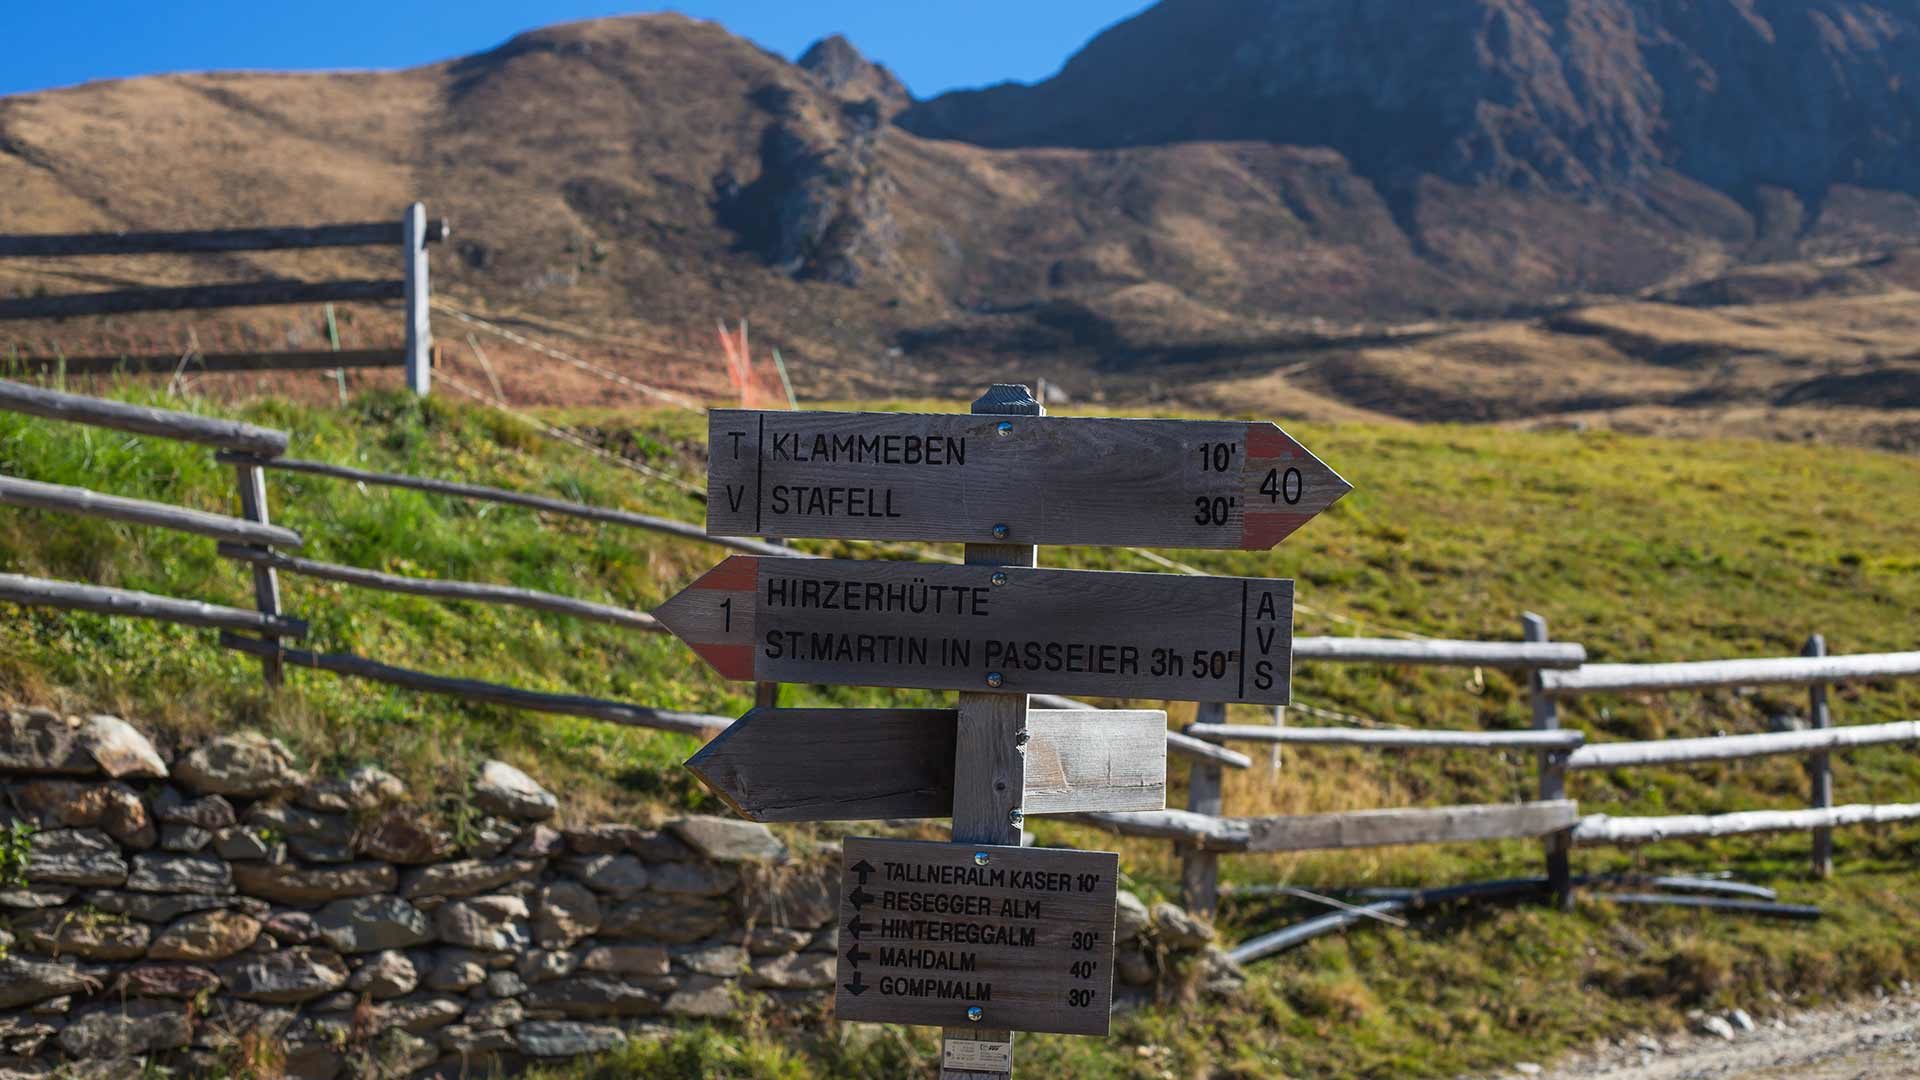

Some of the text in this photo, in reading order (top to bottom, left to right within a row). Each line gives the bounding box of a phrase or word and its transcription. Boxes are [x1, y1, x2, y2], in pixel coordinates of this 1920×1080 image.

[728, 432, 746, 459] T
[772, 433, 966, 465] KLAMMEBEN
[1200, 443, 1236, 472] 10'
[726, 485, 744, 512] V
[771, 485, 902, 517] STAFELL
[1259, 467, 1303, 505] 40
[1195, 497, 1235, 526] 30'
[766, 577, 990, 616] HIRZERHÜTTE
[719, 598, 732, 632] 1
[765, 630, 927, 665] ST.MARTIN
[942, 638, 971, 667] IN
[984, 640, 1140, 675] PASSEIER
[1151, 648, 1183, 676] 3h
[884, 862, 1100, 893] TALLNERALM KASER 10'
[882, 891, 1041, 919] RESEGGER ALM
[880, 919, 1098, 951] HINTEREGGALM 30'
[879, 947, 1097, 979] MAHDALM 40'
[879, 977, 1095, 1007] GOMPMALM 30'
